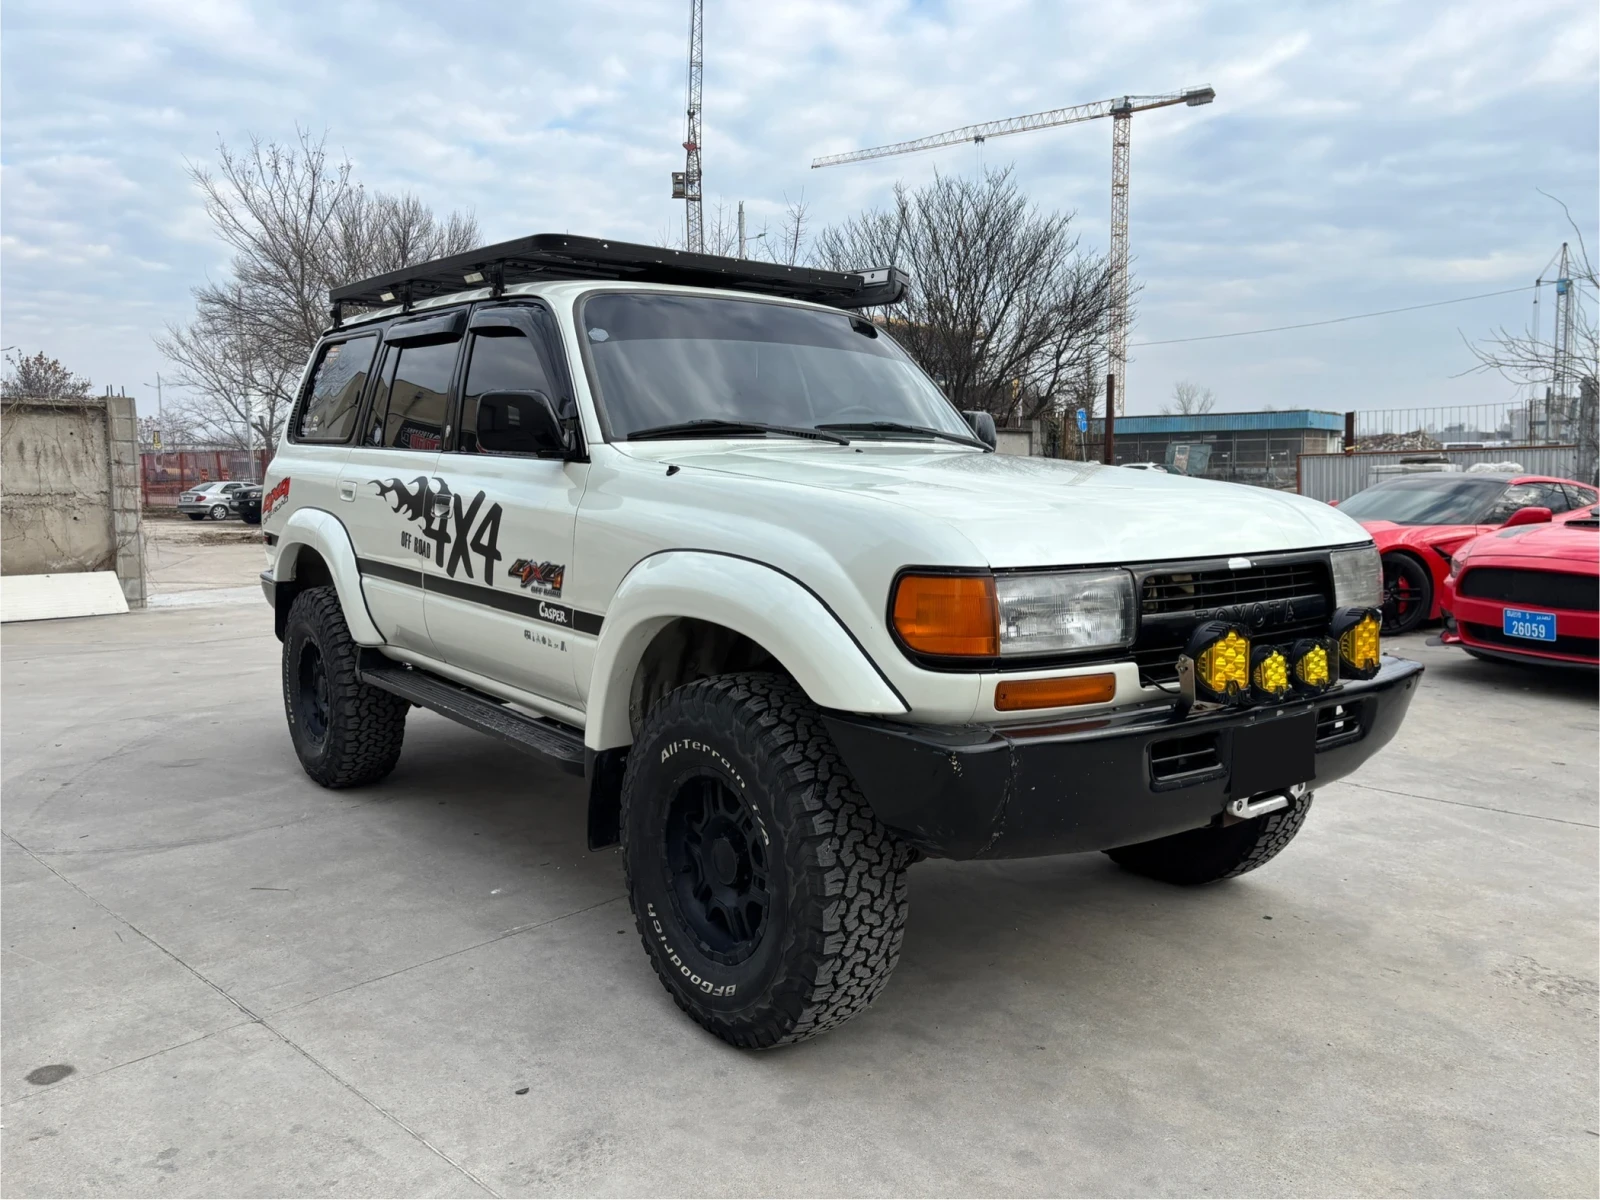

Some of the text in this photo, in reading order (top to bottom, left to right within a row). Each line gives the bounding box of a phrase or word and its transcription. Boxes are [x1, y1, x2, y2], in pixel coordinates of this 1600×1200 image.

[401, 531, 431, 559] OFF ROAD
[1512, 620, 1546, 638] 26059
[660, 738, 746, 789] All-Terrain
[647, 902, 737, 998] BFGoodrich
